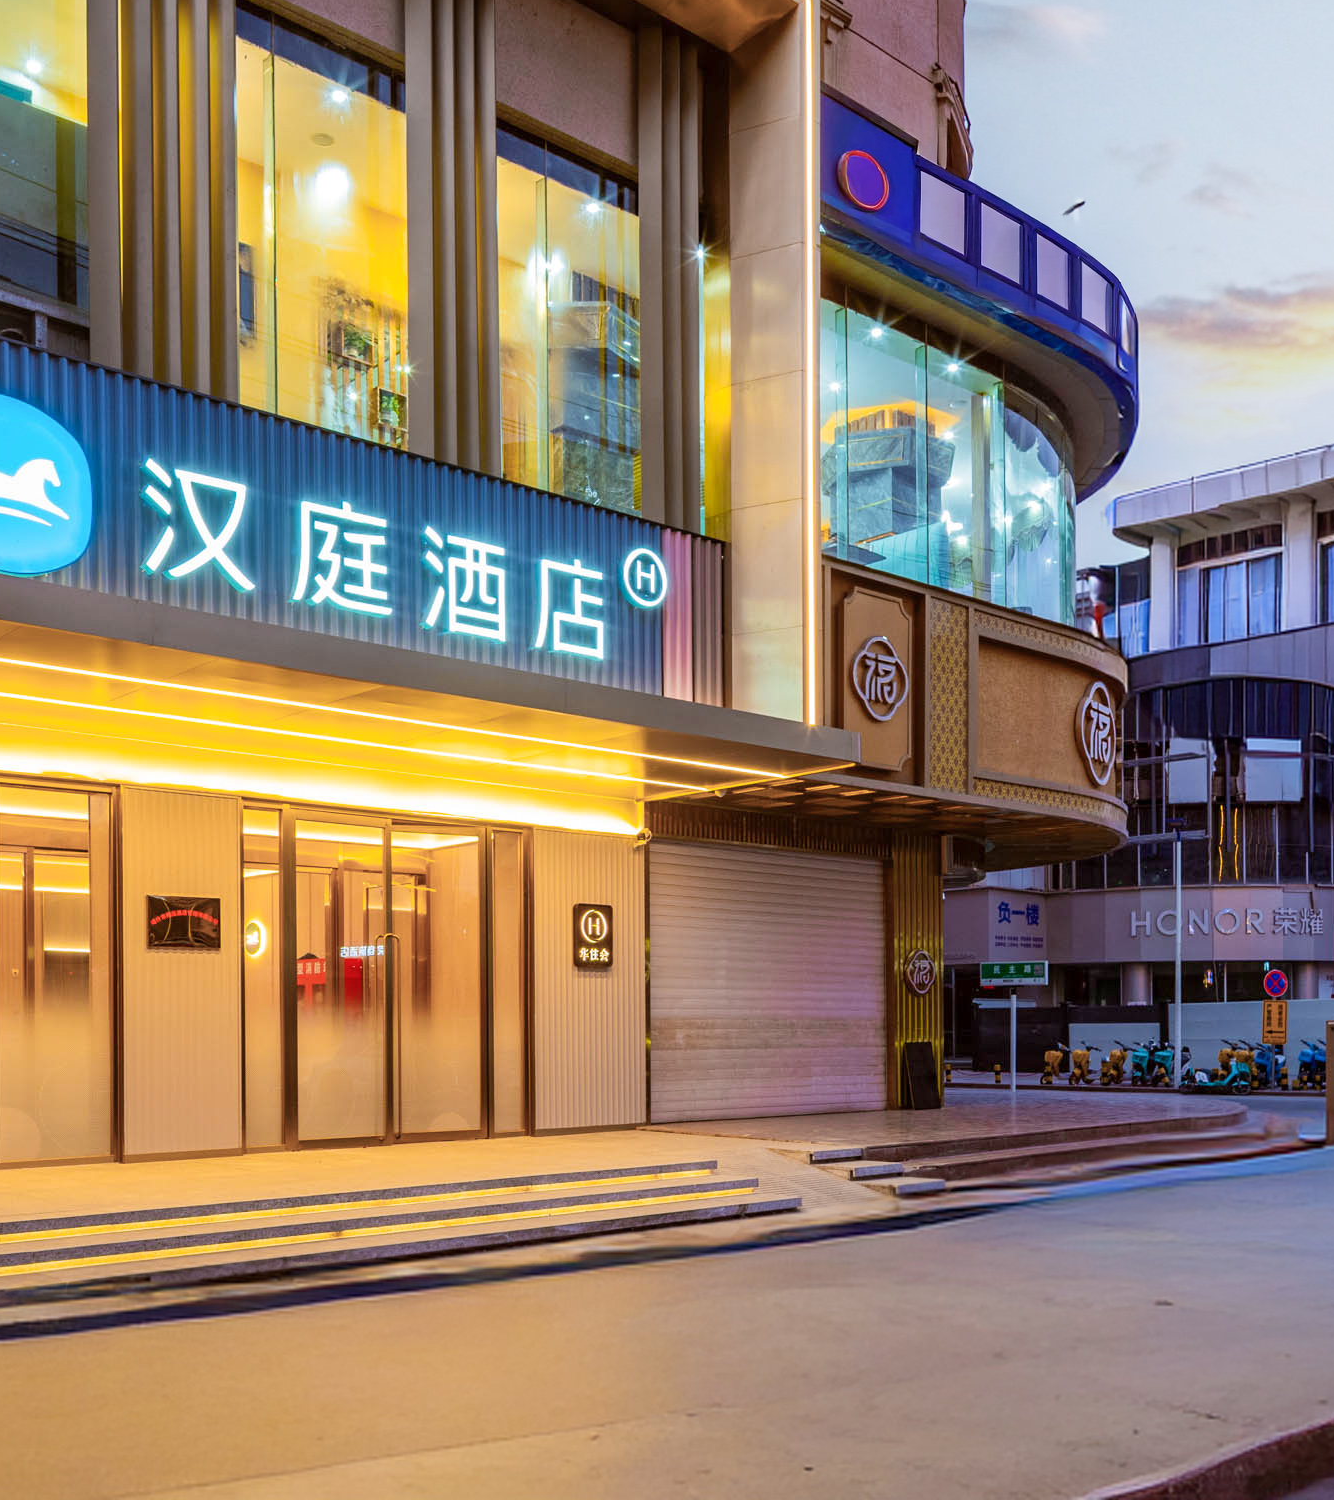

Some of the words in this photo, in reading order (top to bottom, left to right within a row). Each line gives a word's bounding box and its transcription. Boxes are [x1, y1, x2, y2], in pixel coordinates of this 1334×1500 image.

[141, 456, 609, 662] 汉庭酒店
[997, 901, 1041, 926] 负一楼
[1129, 907, 1266, 937] HONOR
[1272, 907, 1324, 936] 荣耀
[579, 947, 610, 963] 华住会
